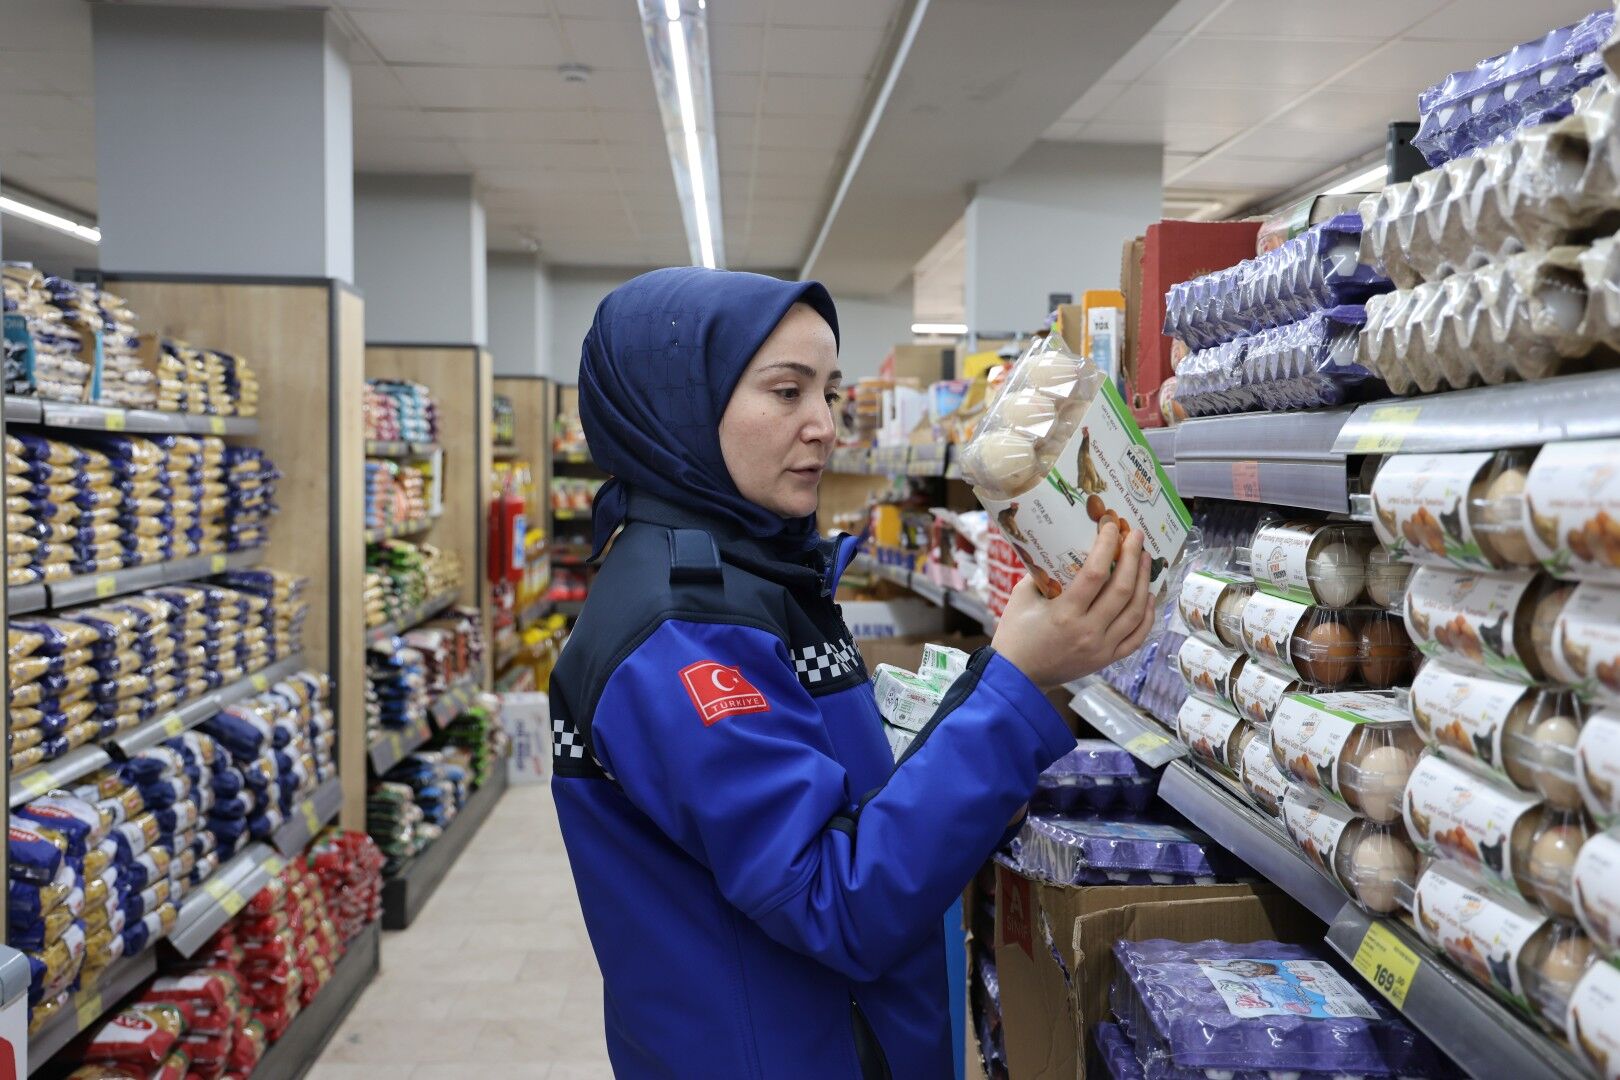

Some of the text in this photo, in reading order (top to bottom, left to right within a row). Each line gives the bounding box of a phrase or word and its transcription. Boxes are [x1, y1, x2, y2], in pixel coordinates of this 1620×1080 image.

[1090, 439, 1110, 469] Serbest
[1108, 467, 1125, 494] Gezen
[1122, 492, 1139, 517] Tavuk
[1126, 449, 1152, 485] KANDIRA
[1373, 963, 1395, 992] 169
